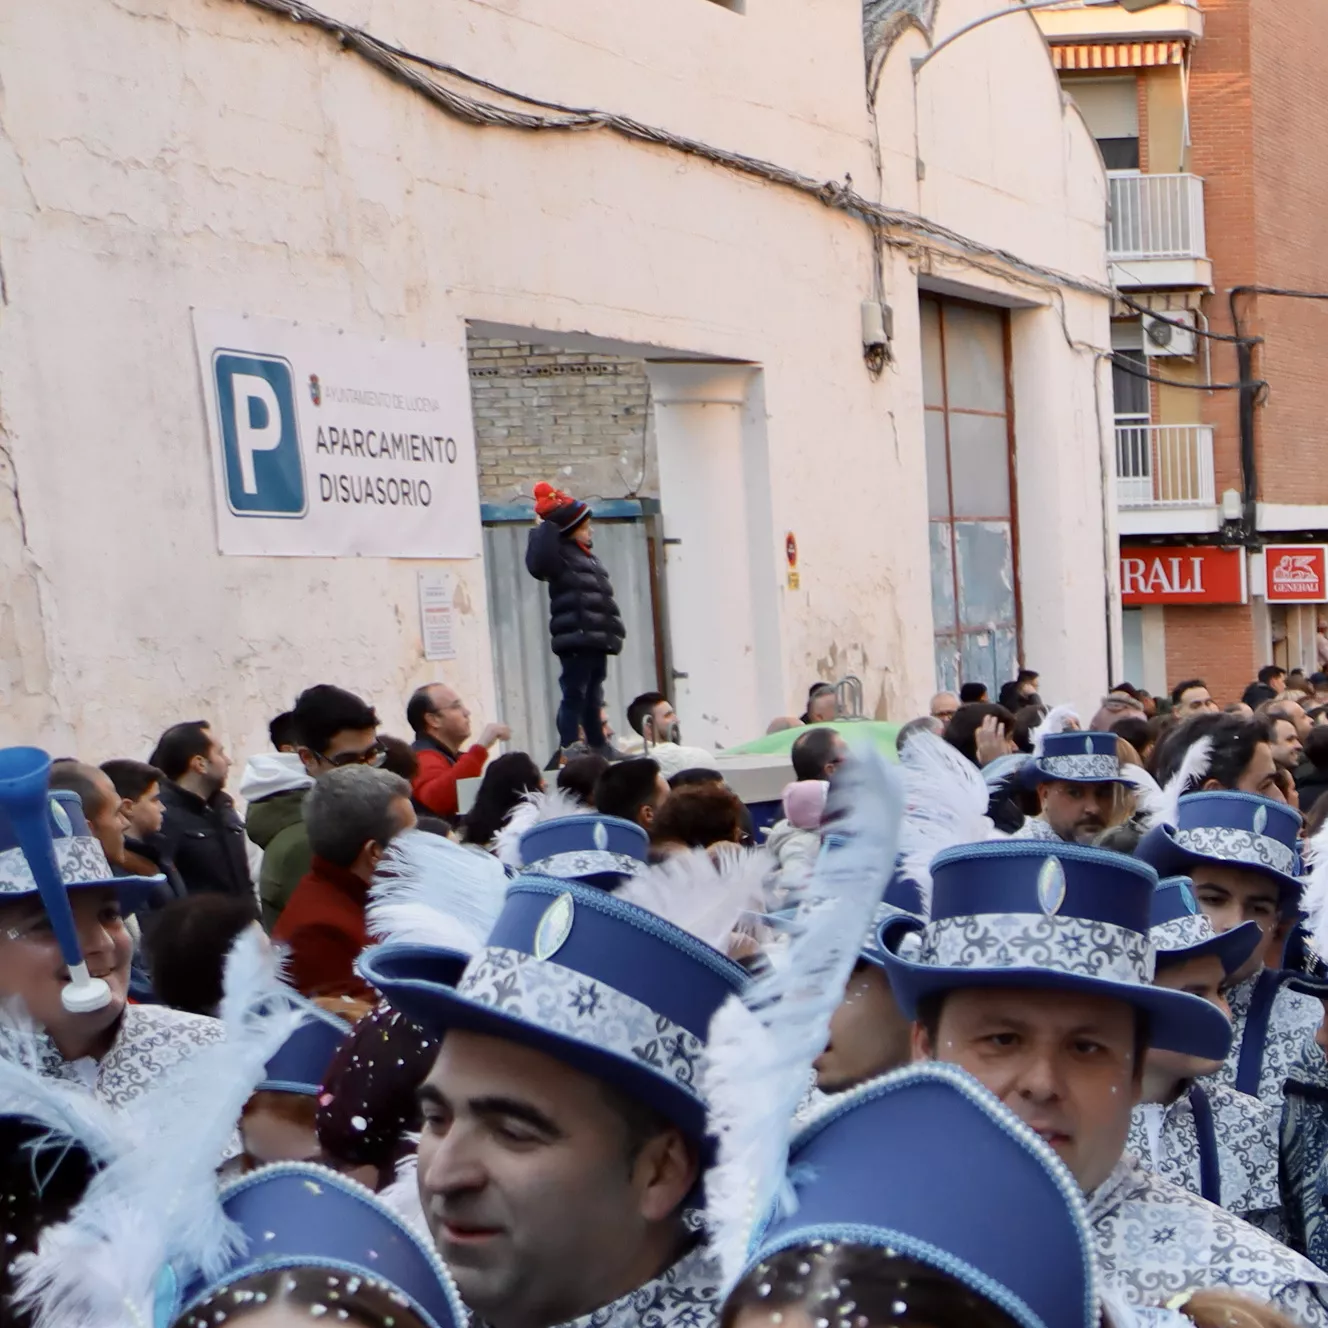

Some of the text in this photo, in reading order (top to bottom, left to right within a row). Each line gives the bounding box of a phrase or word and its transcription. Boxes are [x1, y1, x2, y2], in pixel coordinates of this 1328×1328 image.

[231, 372, 282, 495] P
[315, 425, 457, 464] APARCAMIENTO
[319, 473, 432, 507] DISUASORIO
[1273, 583, 1319, 593] GENERALI
